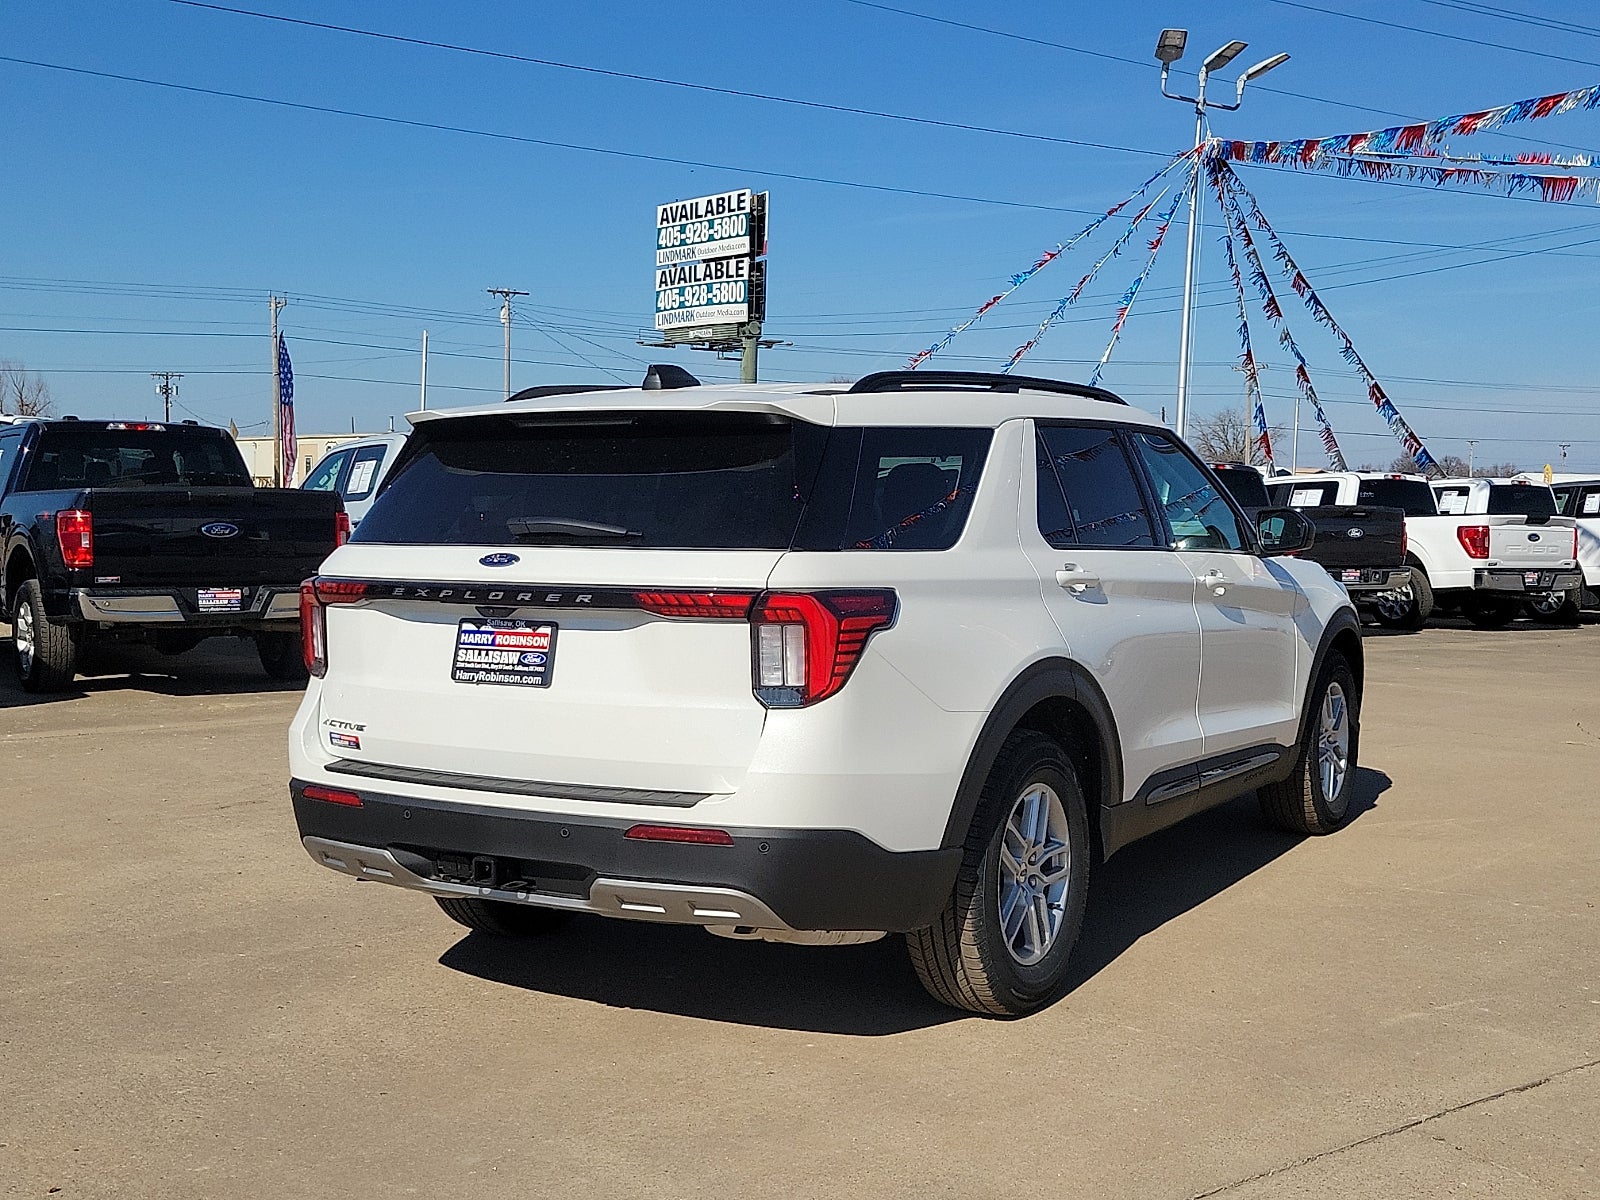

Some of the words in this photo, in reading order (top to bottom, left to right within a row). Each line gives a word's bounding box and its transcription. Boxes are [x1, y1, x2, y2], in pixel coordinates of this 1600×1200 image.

[660, 192, 747, 225] AVAILABLE
[658, 214, 746, 248] 405-928-5800
[658, 247, 697, 264] LINDMARK
[659, 259, 744, 288] AVAILABLE
[657, 281, 744, 311] 405-928-5800
[657, 310, 695, 326] LINDMARK
[392, 588, 592, 603] EXPLORER
[515, 620, 526, 628] OK
[460, 632, 494, 645] HARRY
[495, 634, 549, 647] ROBINSON
[457, 649, 521, 665] SALLISAW
[524, 653, 541, 664] Ford
[455, 670, 542, 685] HarryRobinson.com
[322, 719, 367, 732] ACTIVE
